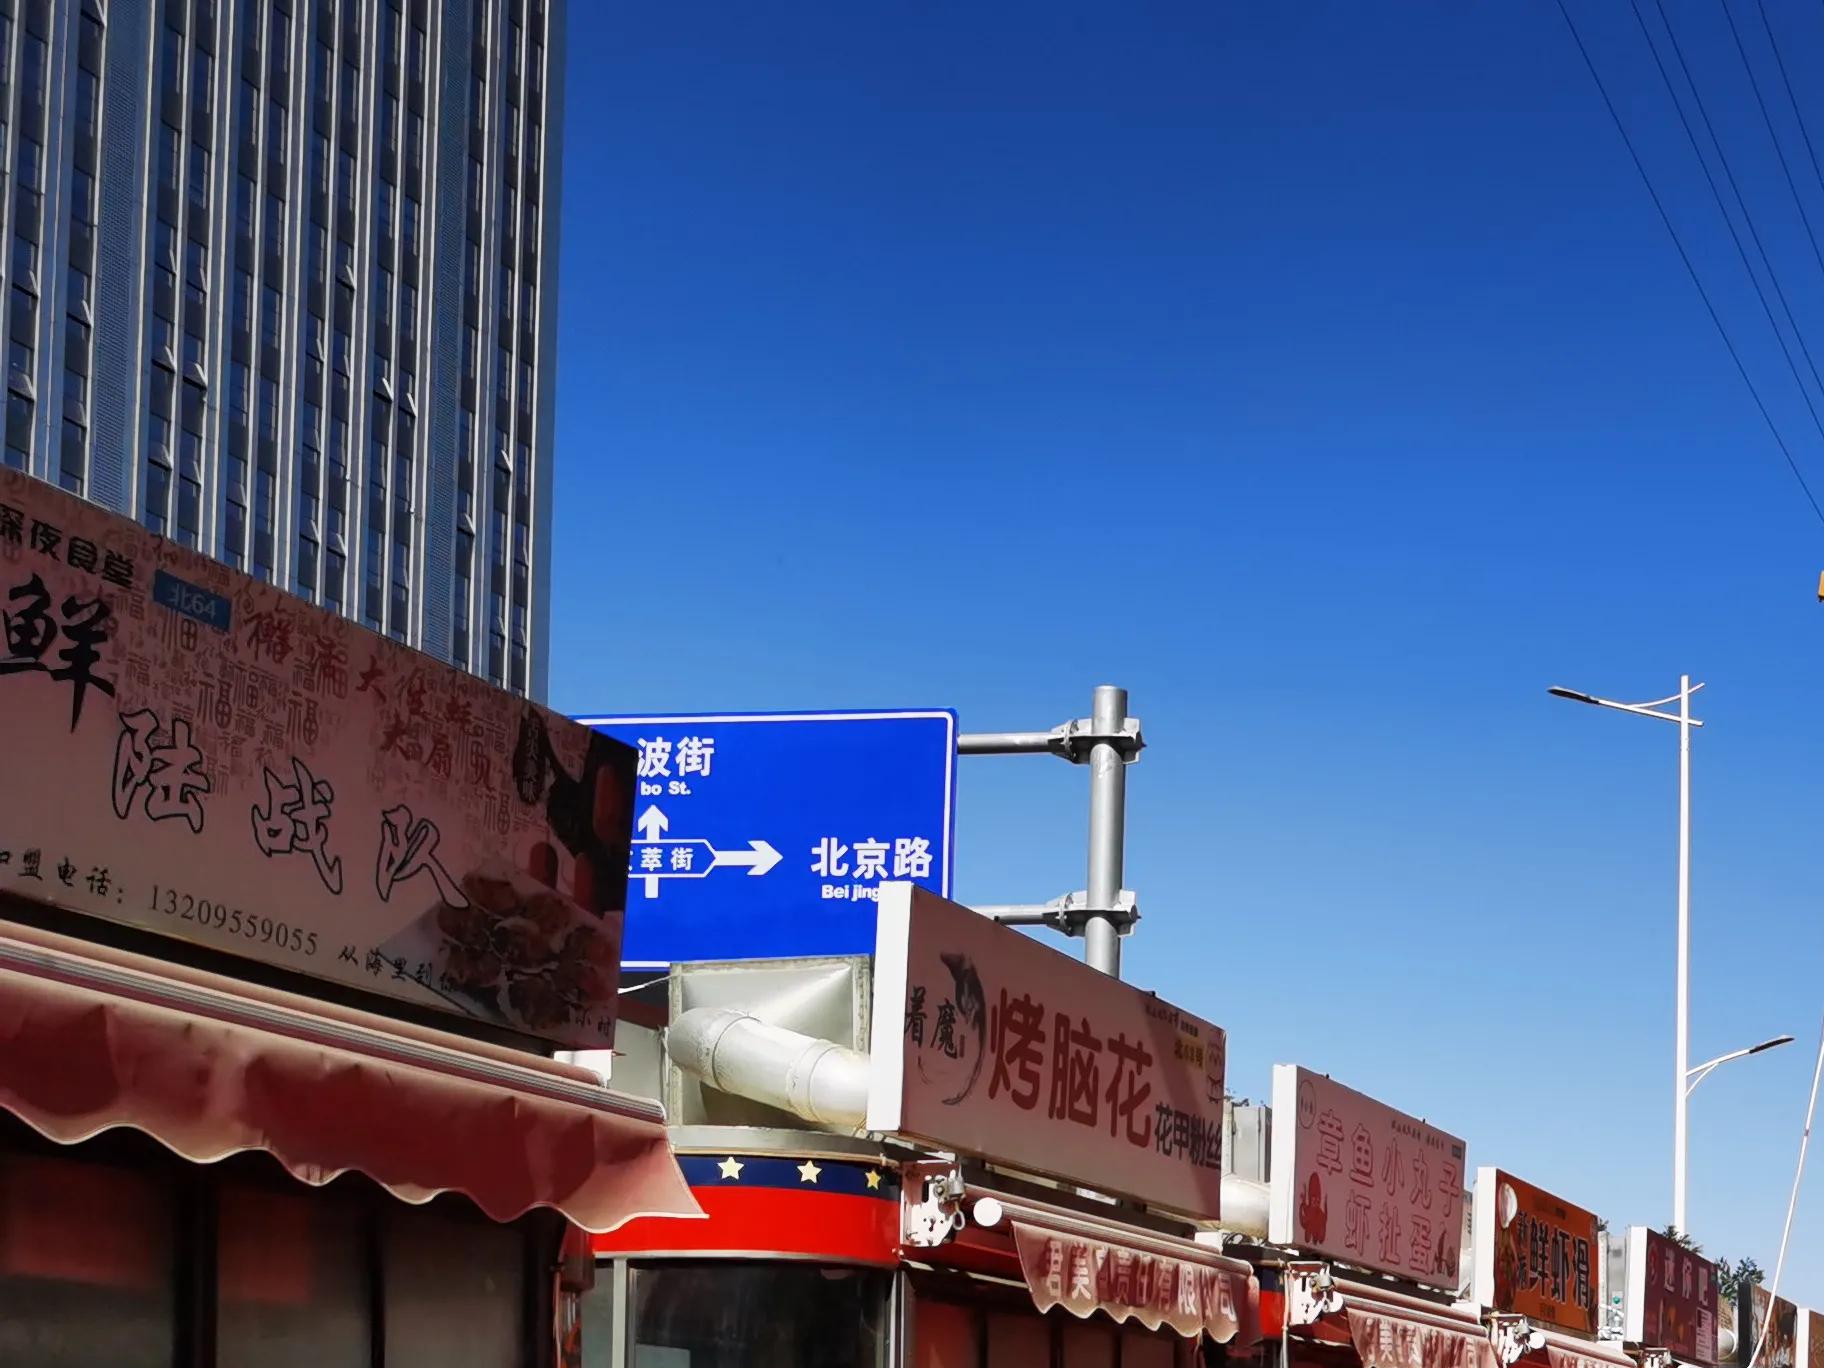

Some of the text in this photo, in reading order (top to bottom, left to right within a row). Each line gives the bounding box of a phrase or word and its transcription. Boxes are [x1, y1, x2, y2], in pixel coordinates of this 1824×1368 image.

[112, 708, 470, 908] 陆战队
[668, 780, 691, 795] St.
[628, 847, 694, 872] 萃街
[811, 837, 934, 879] 北京路
[150, 885, 318, 957] 13209559055
[988, 986, 1154, 1149] 烤脑花
[1154, 1100, 1222, 1170] 花甲粉丝
[1317, 1108, 1459, 1218] 章鱼小丸子
